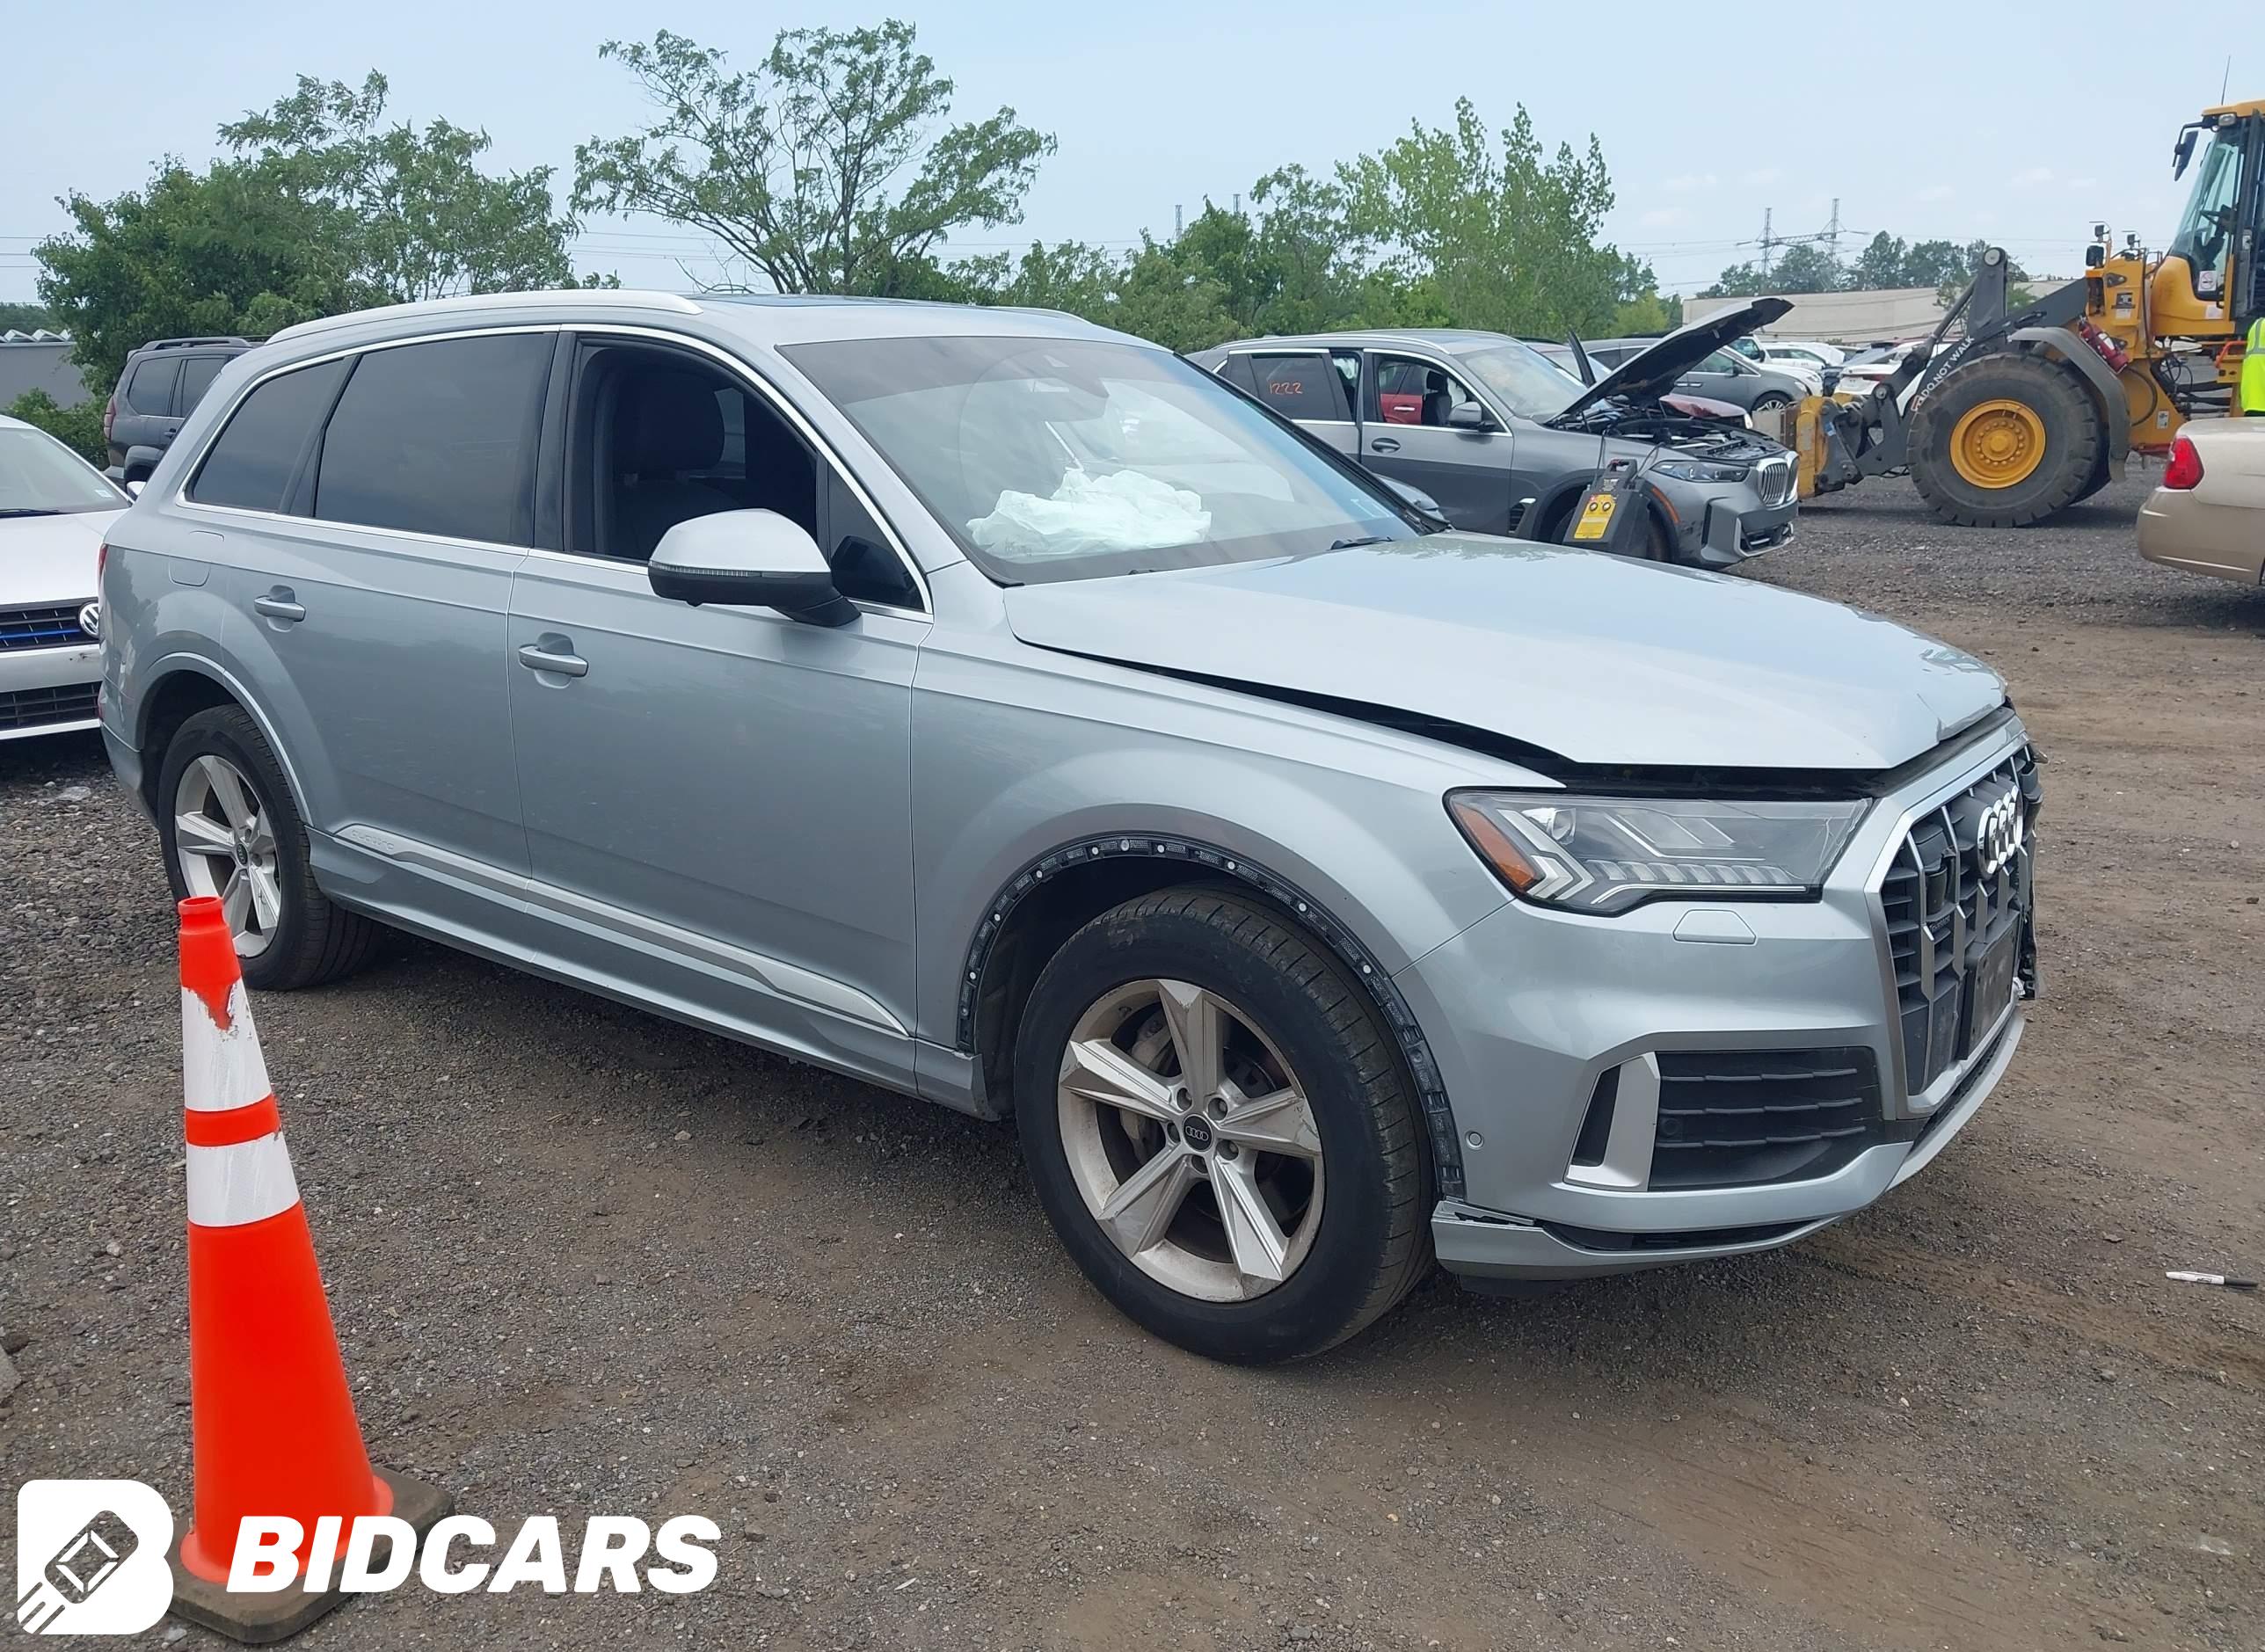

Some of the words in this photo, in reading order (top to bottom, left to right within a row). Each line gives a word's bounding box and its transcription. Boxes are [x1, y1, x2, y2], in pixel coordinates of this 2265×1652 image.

[1920, 382, 1935, 398] DO
[1933, 360, 1952, 383] NOT
[1949, 336, 1975, 361] WALK
[1269, 382, 1303, 396] 1222
